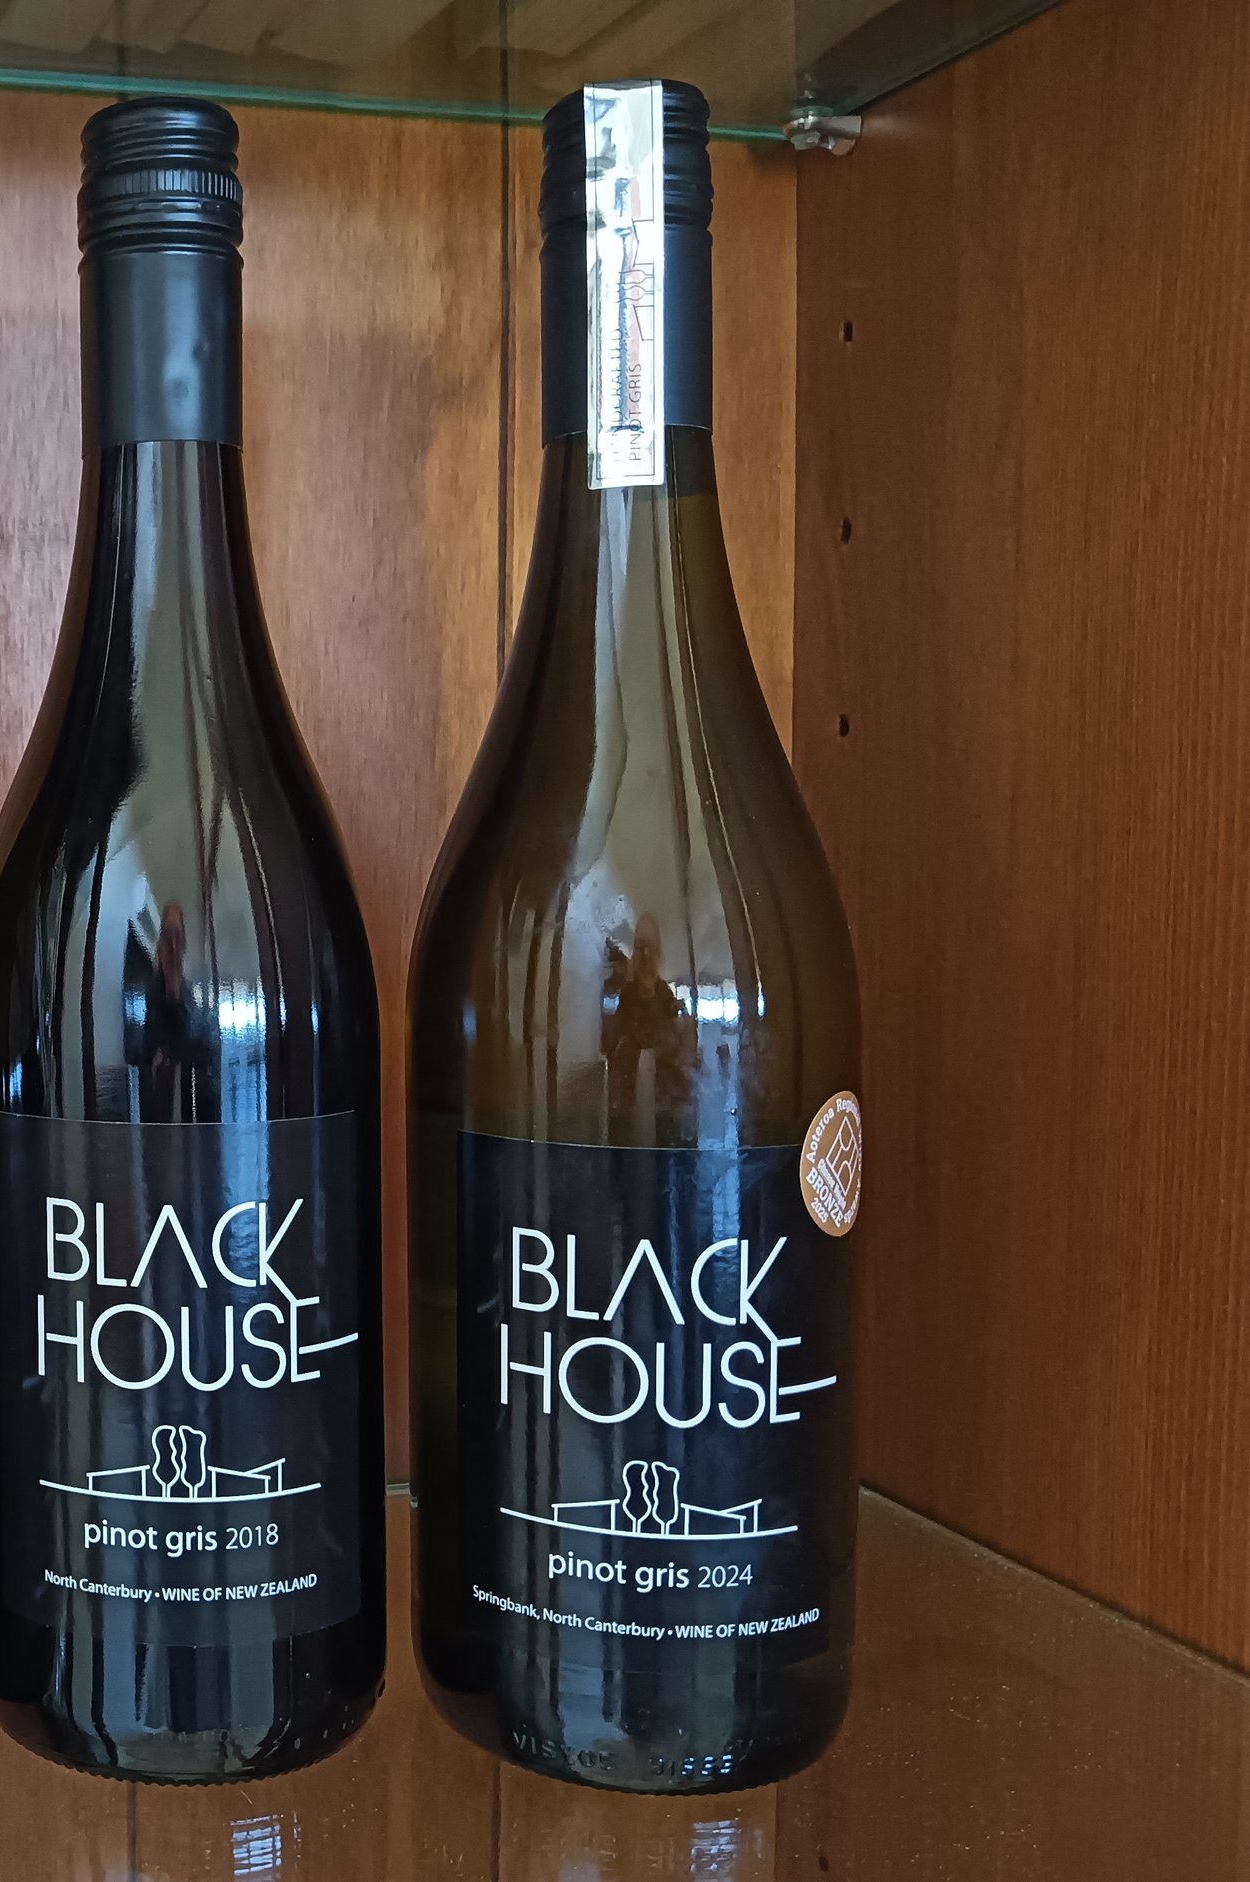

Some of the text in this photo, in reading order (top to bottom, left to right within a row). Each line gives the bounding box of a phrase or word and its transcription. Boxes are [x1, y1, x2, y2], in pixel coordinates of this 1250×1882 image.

[628, 363, 642, 404] GRIS
[806, 1167, 844, 1228] BRONZE
[811, 1197, 830, 1223] 2025
[45, 1196, 303, 1288] BLACK
[511, 1225, 787, 1327] BLACK
[37, 1294, 359, 1391] HOUSE
[500, 1323, 837, 1429] HOUSE
[84, 1519, 279, 1558] pinot gris 2018
[44, 1568, 318, 1603] North Canterbury WINE OF NEW ZEALAND
[548, 1551, 754, 1593] pinot gris 2024
[472, 1584, 820, 1640] Springbank, North Canterbury WINE OF NEW ZEALAND
